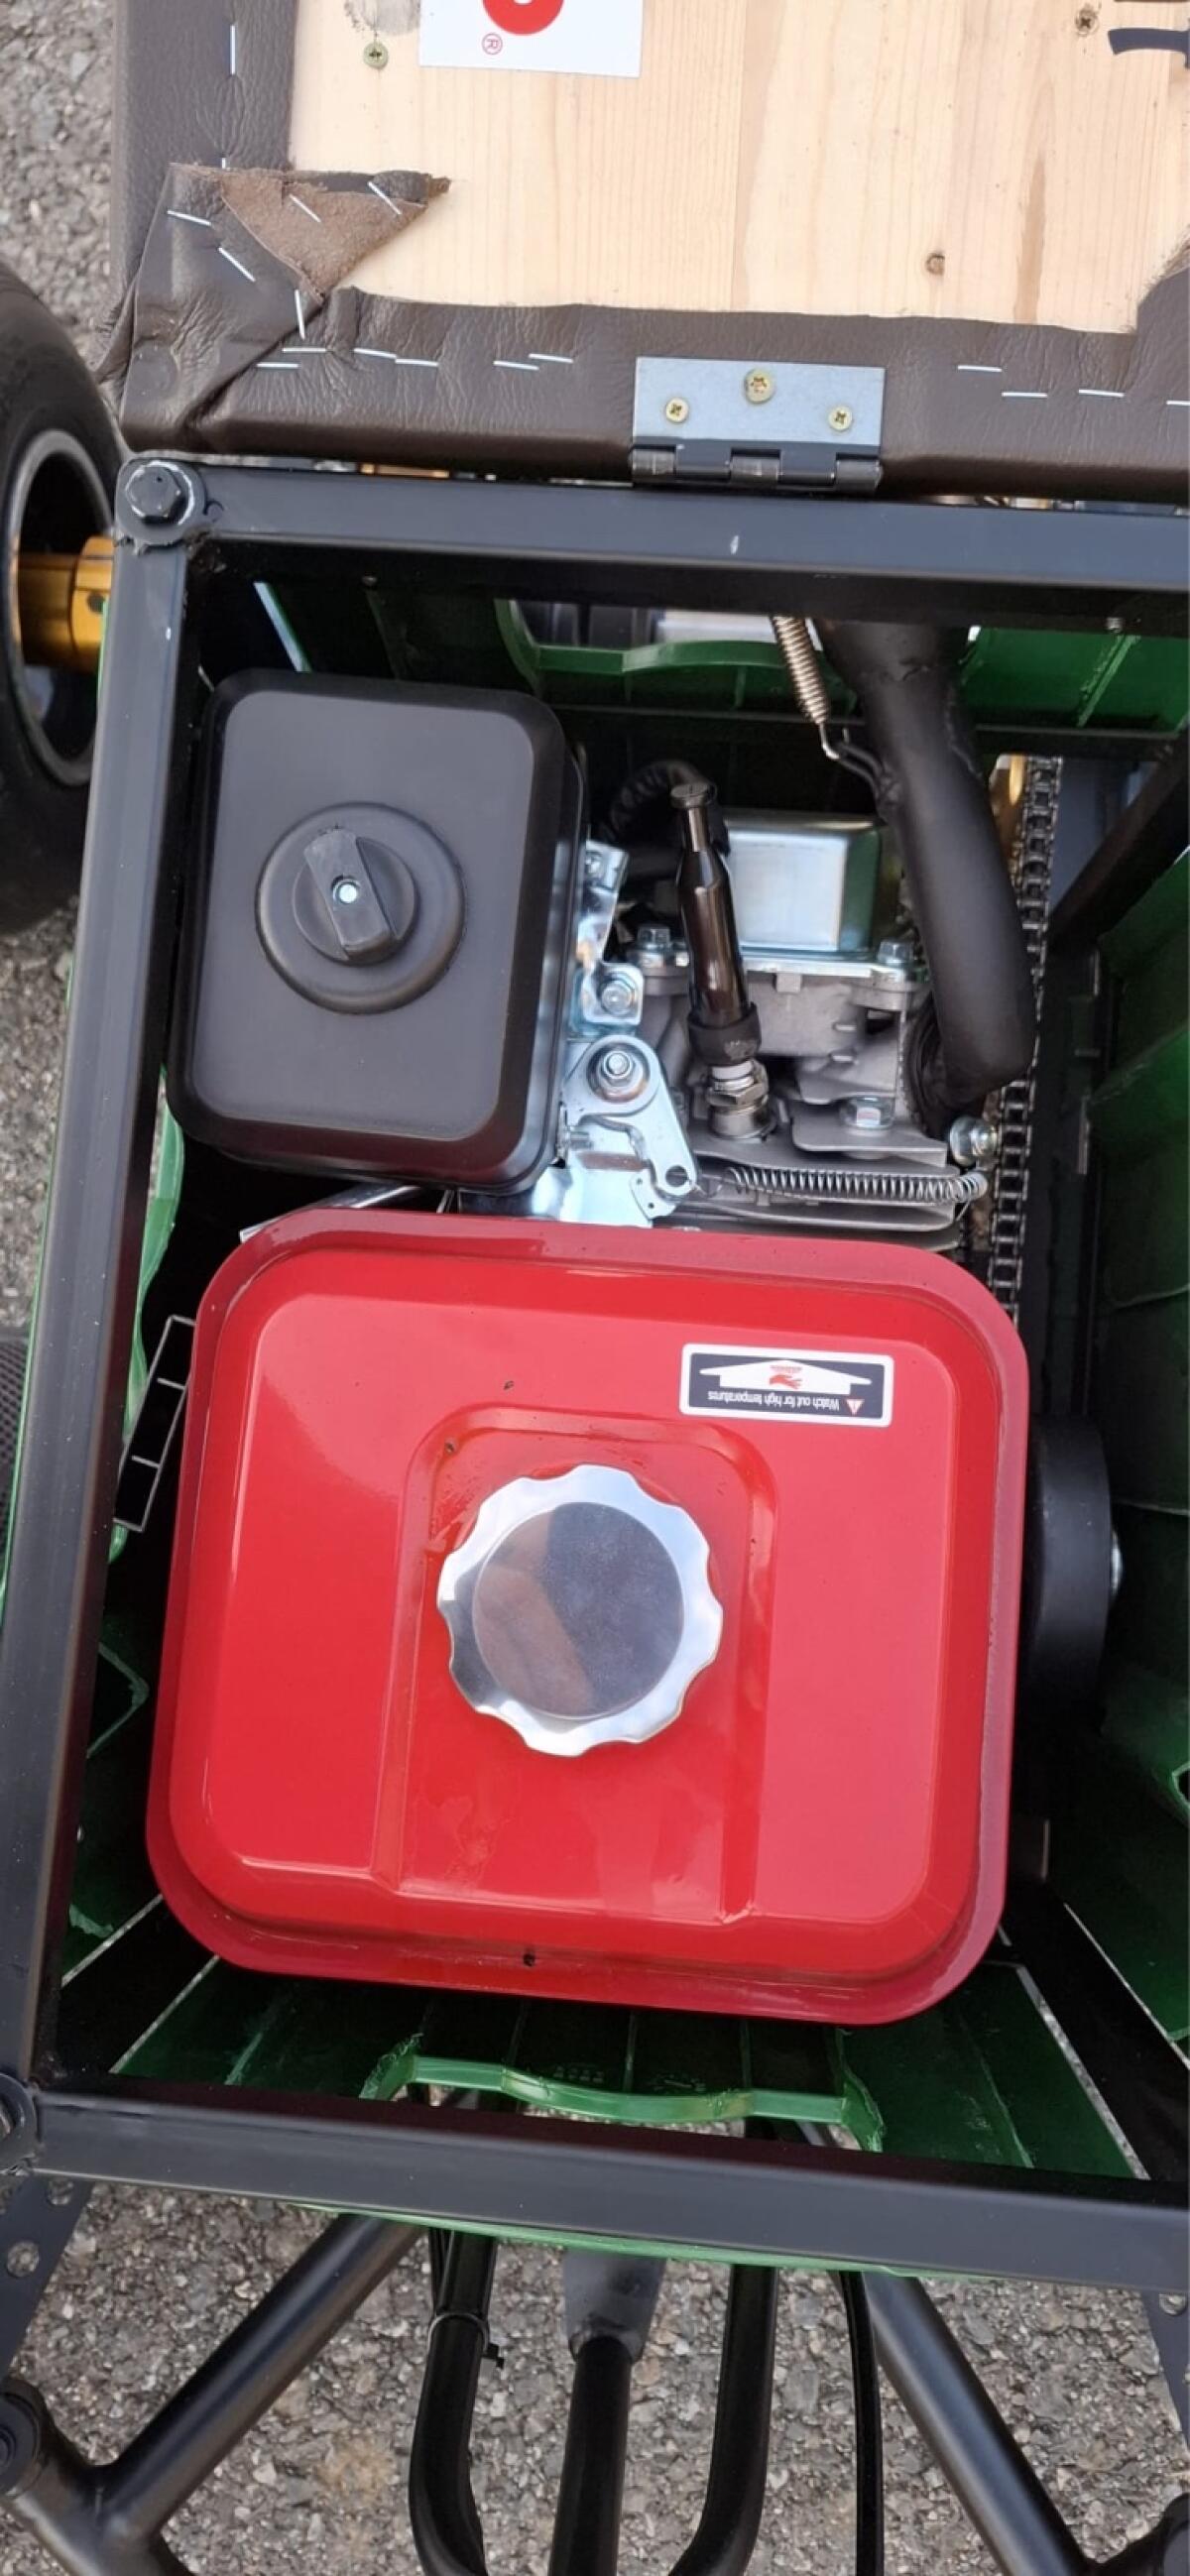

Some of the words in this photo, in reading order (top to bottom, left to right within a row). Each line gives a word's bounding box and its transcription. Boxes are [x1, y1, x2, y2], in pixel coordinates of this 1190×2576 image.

[707, 1390, 763, 1405] temperatures
[764, 1392, 782, 1407] high
[781, 1395, 796, 1408] for
[796, 1396, 811, 1409] out
[812, 1397, 840, 1411] Watch
